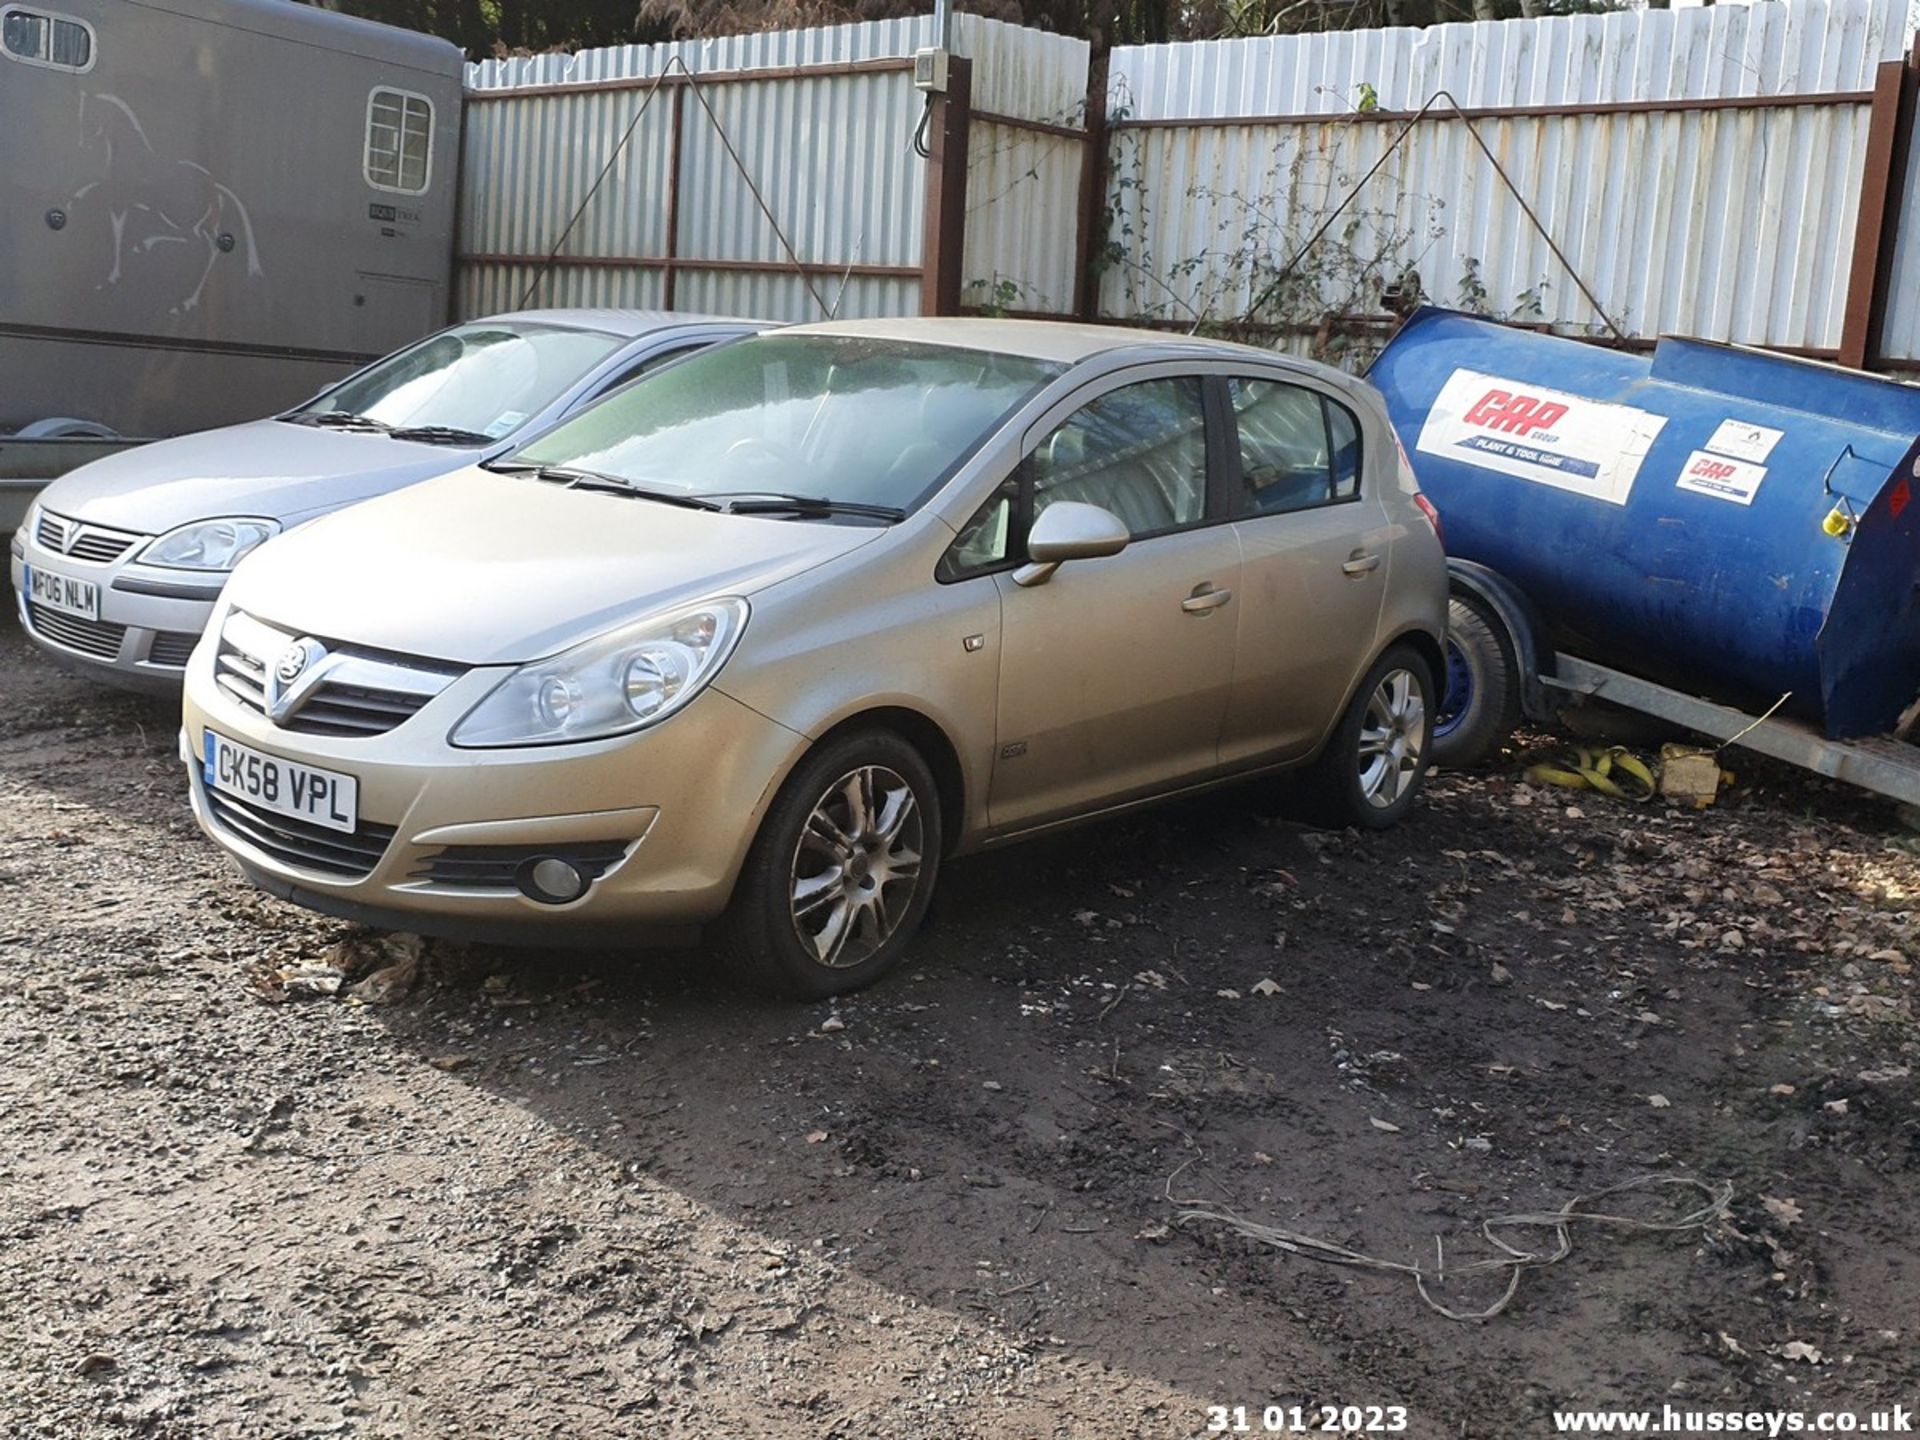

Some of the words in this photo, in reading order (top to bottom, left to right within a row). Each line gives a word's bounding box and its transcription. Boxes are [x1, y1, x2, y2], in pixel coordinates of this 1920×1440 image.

[1475, 439, 1505, 453] PLANT
[1504, 445, 1516, 456] &
[1515, 448, 1538, 461] TOOL
[1538, 454, 1564, 466] HIRE
[31, 569, 61, 603] WF06
[65, 579, 94, 613] NLM
[220, 743, 279, 802] CK58
[289, 767, 349, 823] VPL
